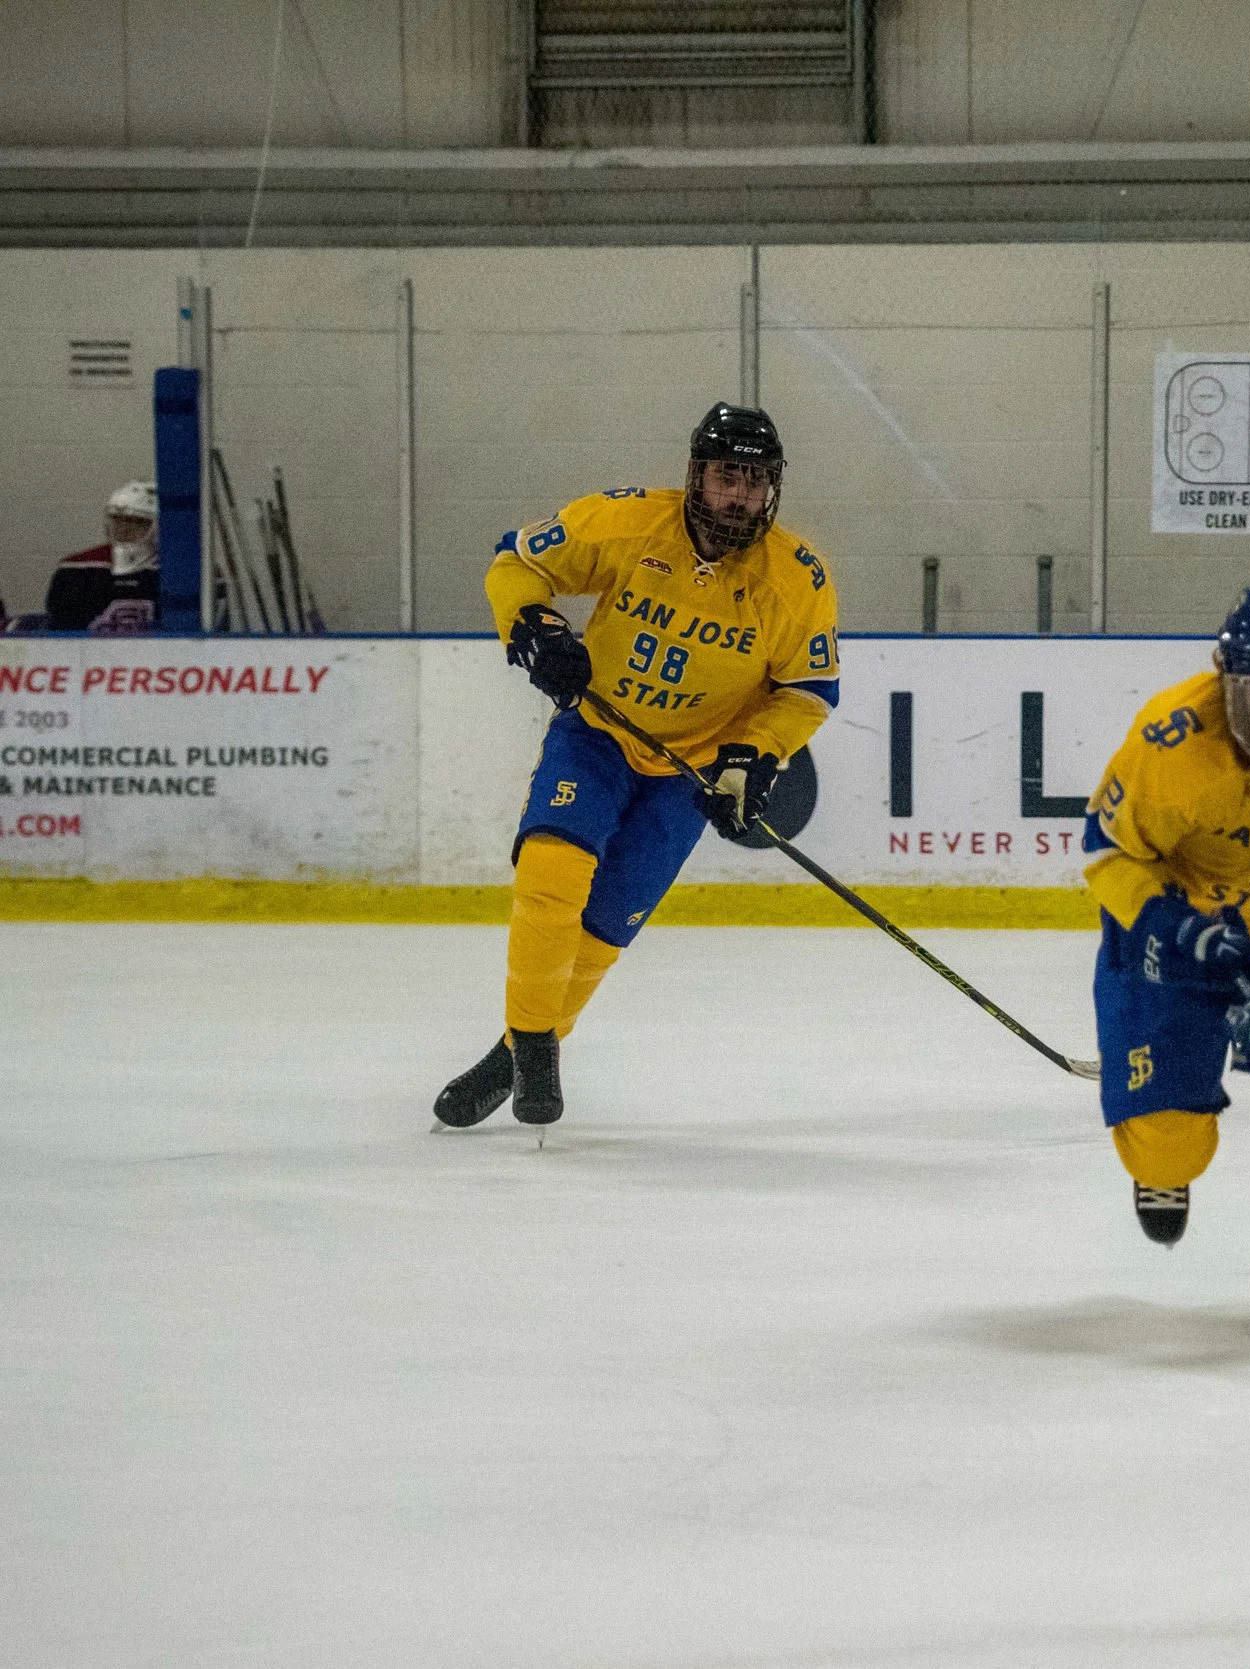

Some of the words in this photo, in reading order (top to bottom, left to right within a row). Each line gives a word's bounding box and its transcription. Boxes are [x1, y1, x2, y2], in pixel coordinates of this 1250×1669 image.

[733, 445, 763, 454] CCM
[1179, 490, 1205, 506] USE
[1205, 513, 1247, 529] CLEAN
[615, 590, 676, 630] SAN
[680, 616, 757, 655] JOSÉ
[627, 631, 691, 686] 98
[808, 625, 840, 671] 9
[82, 666, 330, 694] PERSONALLY
[613, 676, 708, 711] STATE
[15, 710, 69, 730] 2003
[1, 746, 176, 767] COMMERCIAL
[186, 746, 330, 767] PLUMBING
[23, 776, 217, 797] MAINTENANCE
[0, 815, 81, 837] .COM
[890, 832, 1013, 854] NEVER
[1036, 832, 1086, 855] ST
